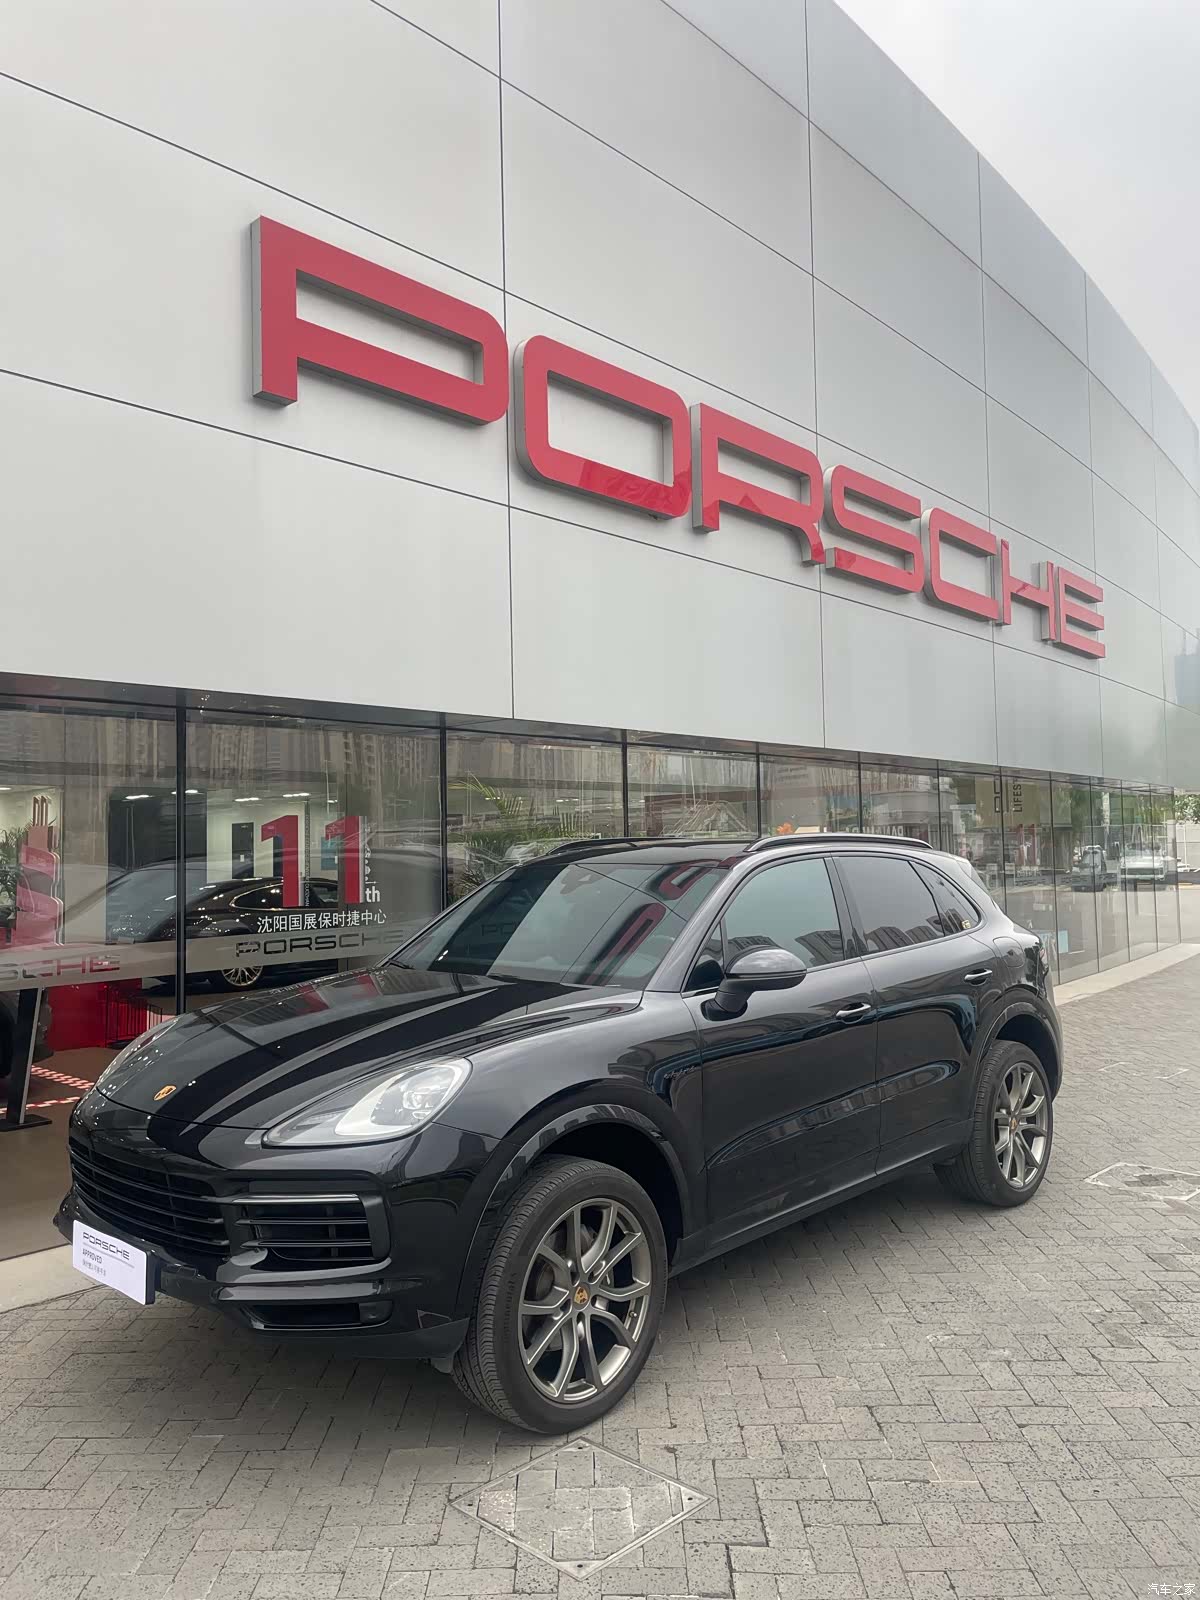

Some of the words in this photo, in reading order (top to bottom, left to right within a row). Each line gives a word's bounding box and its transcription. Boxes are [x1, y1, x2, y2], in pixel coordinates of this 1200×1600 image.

[251, 215, 1106, 659] PORSCHE
[256, 908, 387, 934] 沈阳国展保时捷中心
[235, 929, 404, 958] PORSCHE
[82, 1231, 130, 1261] PORSCHE
[82, 1247, 103, 1264] APPROVED
